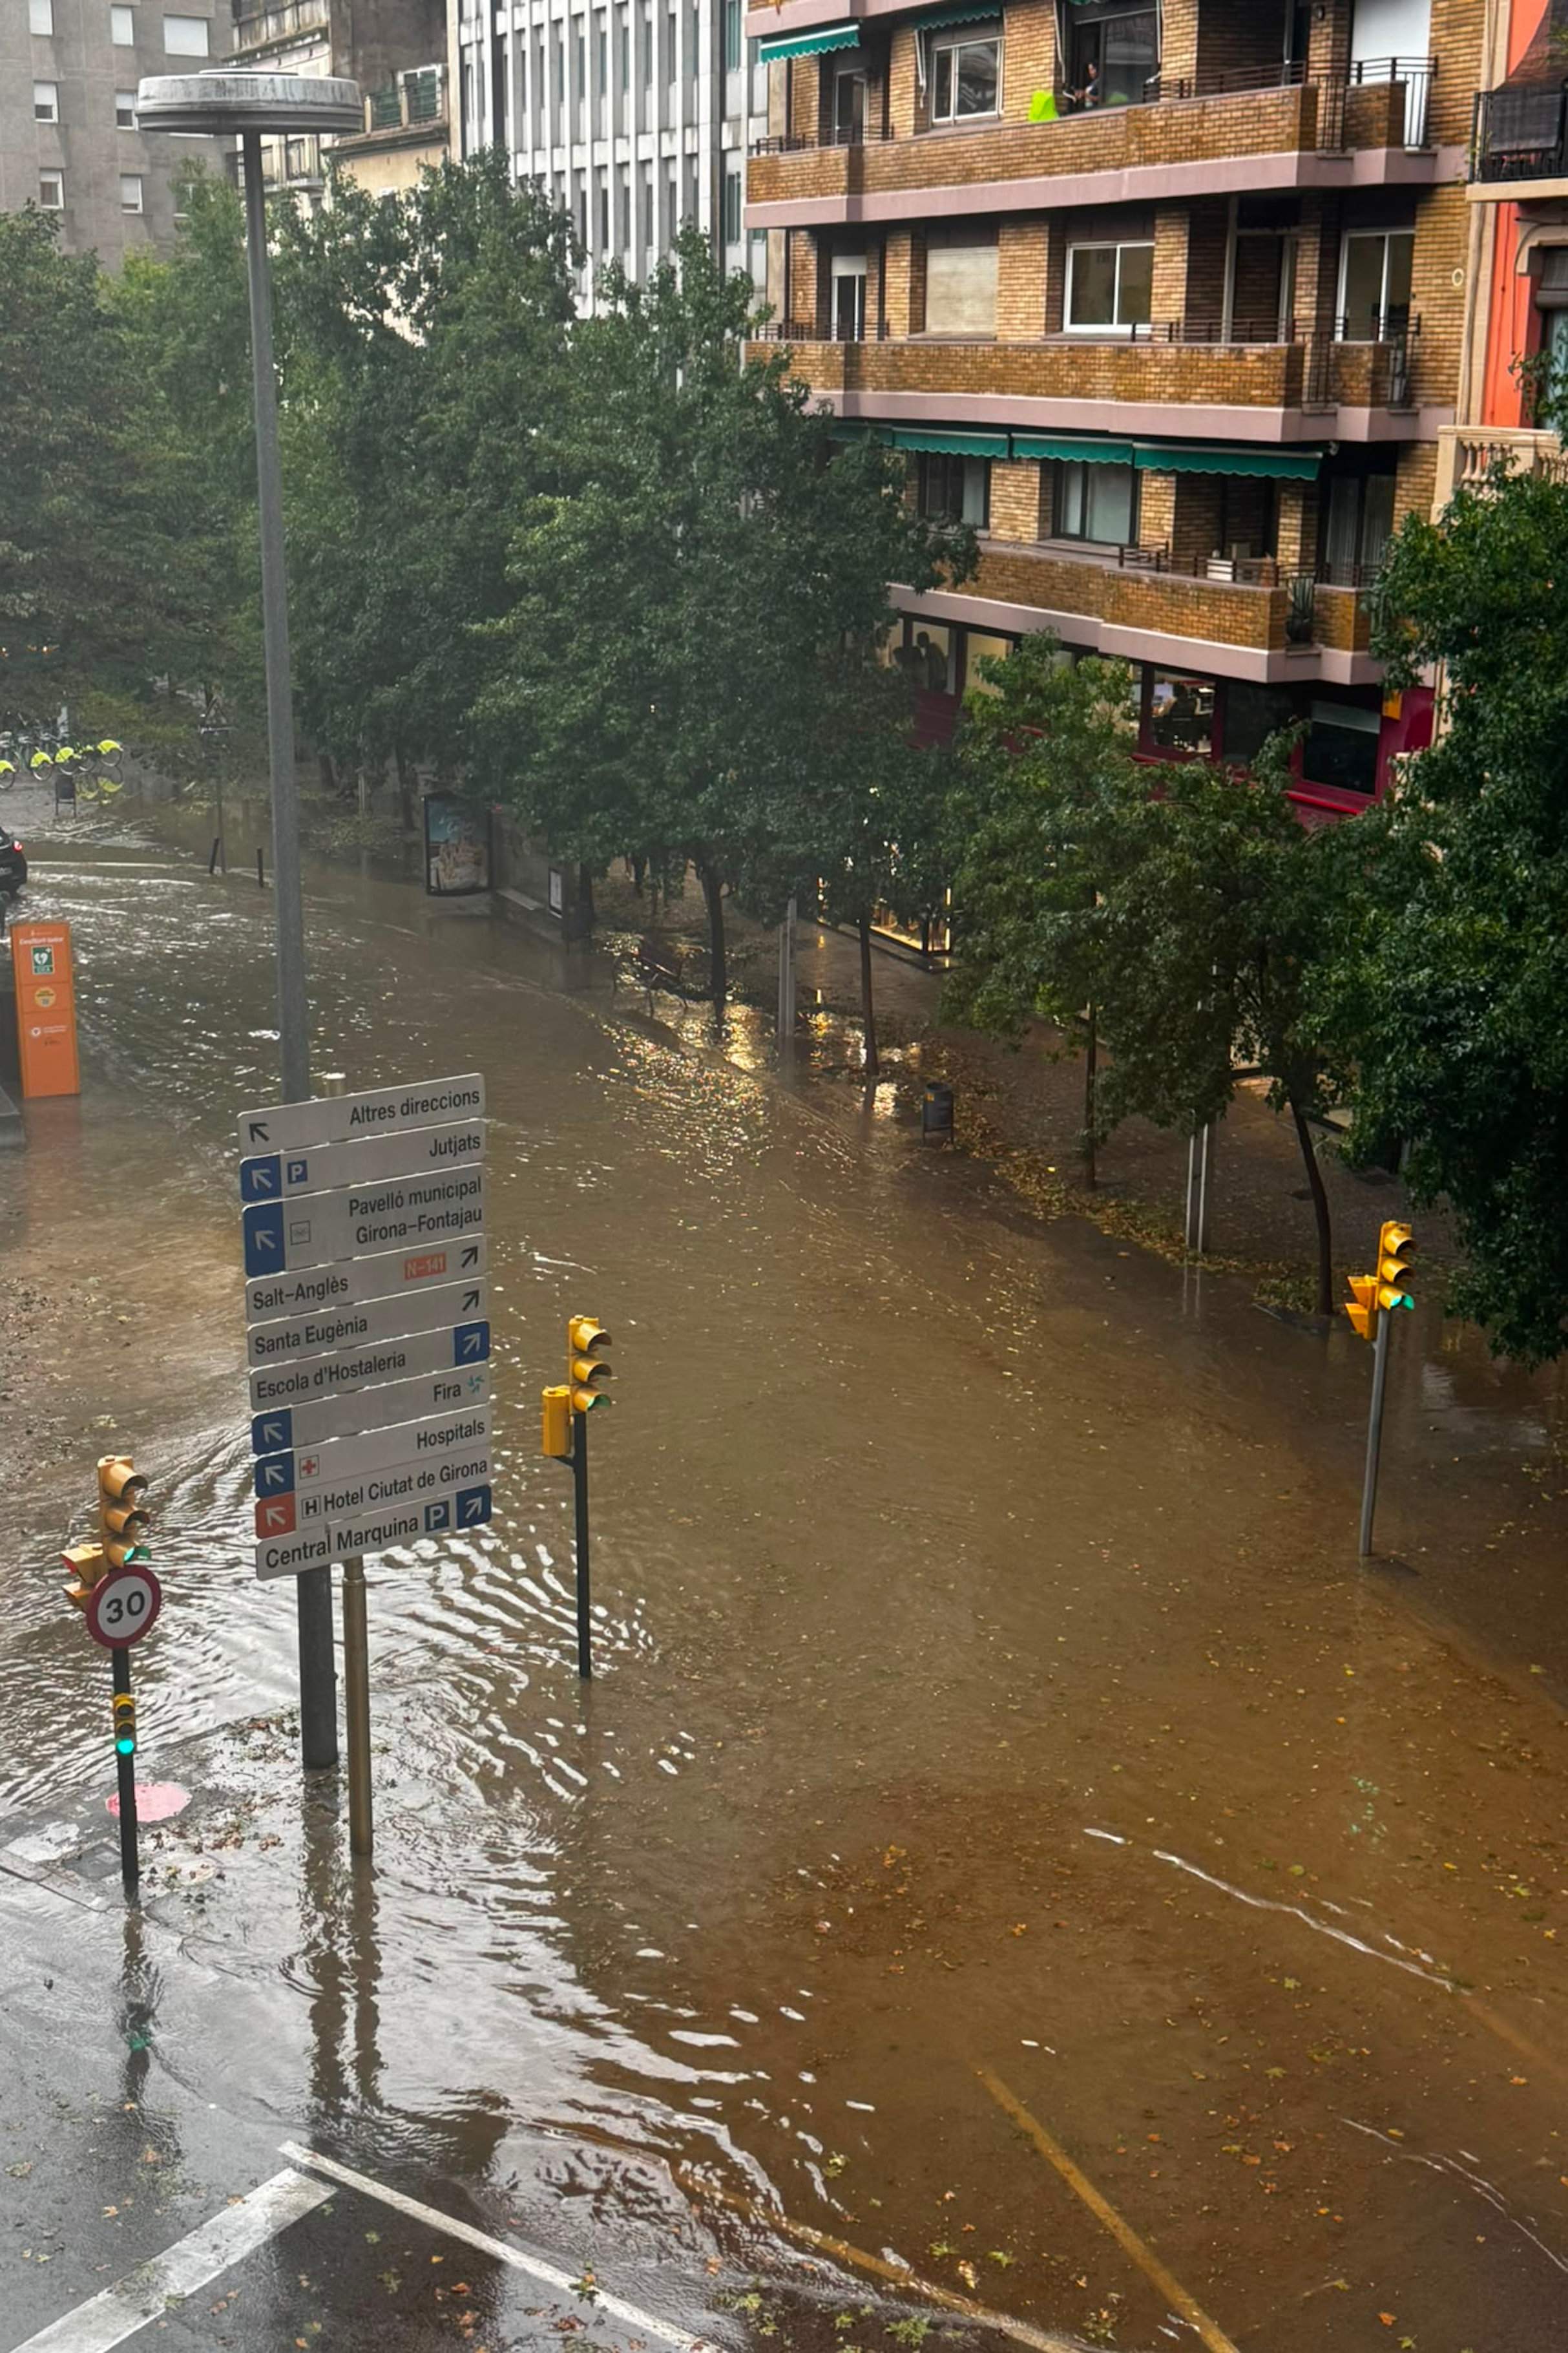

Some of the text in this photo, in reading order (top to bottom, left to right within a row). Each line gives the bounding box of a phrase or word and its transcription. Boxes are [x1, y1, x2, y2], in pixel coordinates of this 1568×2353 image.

[350, 1090, 480, 1125] Altres direccions
[430, 1134, 481, 1158] Jutjats
[291, 1164, 304, 1181] P
[349, 1176, 481, 1217] Pavelló municipal
[356, 1207, 482, 1244] Girona-Fontajau
[406, 1256, 444, 1278] N-141
[253, 1276, 348, 1310] Salt-Anglès
[255, 1317, 368, 1355] Santa Eugènia
[257, 1353, 406, 1398] Escola d'Hostaleria
[434, 1383, 461, 1402] Fira
[417, 1419, 485, 1450] Hospitals
[305, 1459, 487, 1515] H Hotel Ciutat de Girona
[266, 1506, 444, 1568] Central Marquina P
[106, 1590, 145, 1624] 30
